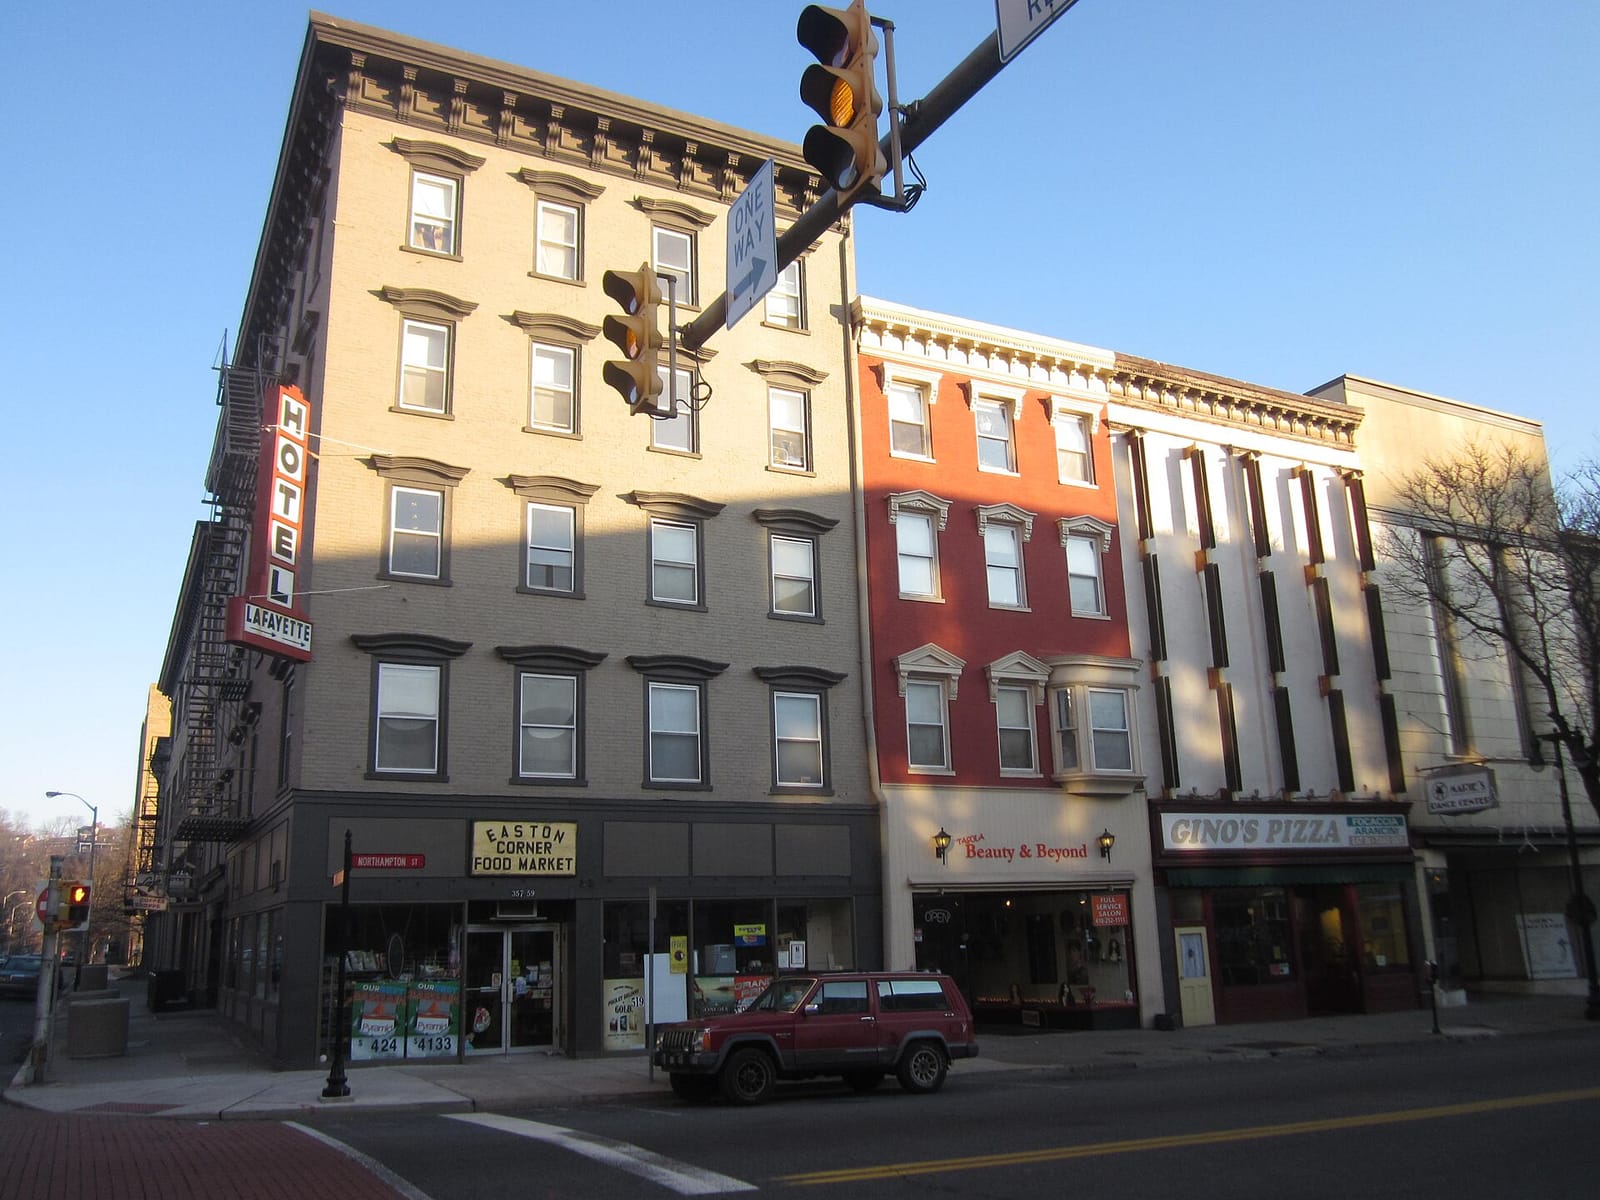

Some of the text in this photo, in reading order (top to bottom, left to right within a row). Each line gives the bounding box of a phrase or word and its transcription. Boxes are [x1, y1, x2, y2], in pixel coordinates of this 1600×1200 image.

[735, 182, 763, 234] ONE
[734, 211, 765, 267] WAY
[270, 400, 302, 602] HOTEL
[246, 605, 310, 642] LAFAYETTE
[1351, 817, 1400, 826] FOCACCIA
[486, 825, 565, 843] EASTON
[1171, 818, 1341, 845] GINO'S PIZZA
[496, 841, 552, 855] CORNER
[966, 843, 1088, 863] Beauty & Beyond
[357, 856, 418, 867] NORTHAMPTON ST
[474, 857, 574, 871] FOOD MARKET
[924, 911, 951, 923] OPEN
[362, 1022, 394, 1033] Pyramid
[417, 1021, 448, 1032] Pyramid
[371, 1038, 397, 1053] 424
